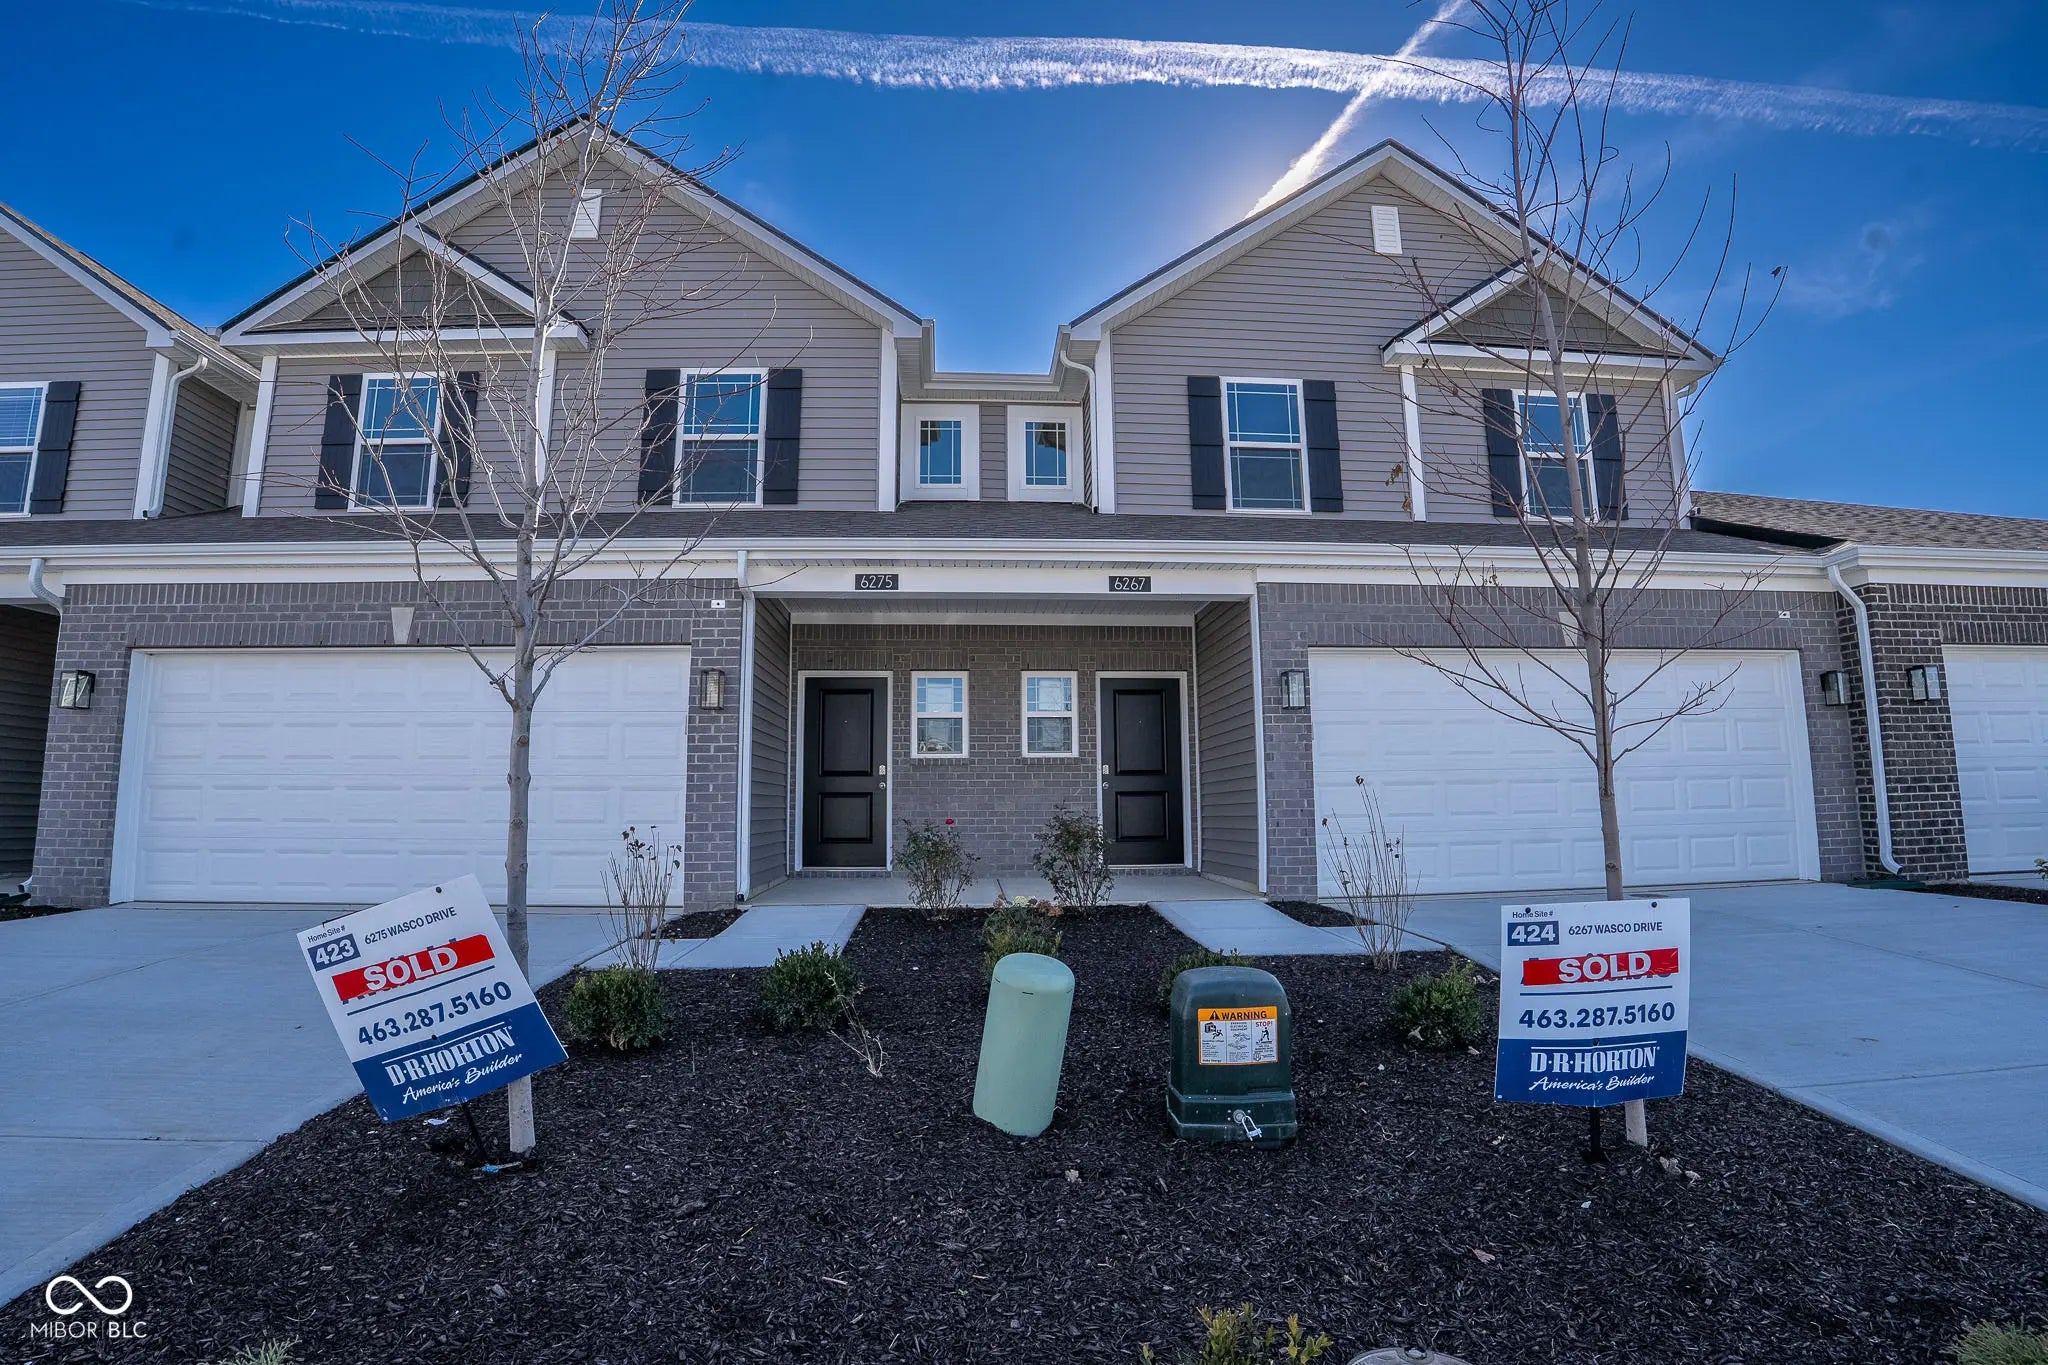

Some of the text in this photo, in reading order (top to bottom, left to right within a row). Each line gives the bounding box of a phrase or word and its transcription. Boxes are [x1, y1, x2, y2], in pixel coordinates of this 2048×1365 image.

[860, 575, 893, 589] 6275
[1113, 577, 1146, 591] 6267
[1512, 911, 1534, 919] Home
[1534, 910, 1549, 918] Site
[364, 907, 457, 945] 6275 WASCO DRIVE
[1511, 925, 1556, 943] 424
[1568, 922, 1663, 936] 6267 WASCO DRIVE
[308, 932, 327, 943] Home
[327, 928, 341, 937] Site
[315, 939, 354, 965] 423
[363, 947, 458, 991] SOLD
[1558, 952, 1652, 983] SOLD
[358, 981, 512, 1046] 463.287.5160
[1221, 1010, 1267, 1020] WARNING
[1519, 1002, 1675, 1029] 463.287.5160
[402, 1053, 523, 1104] America's Builder
[1528, 1073, 1655, 1091] America's Builder
